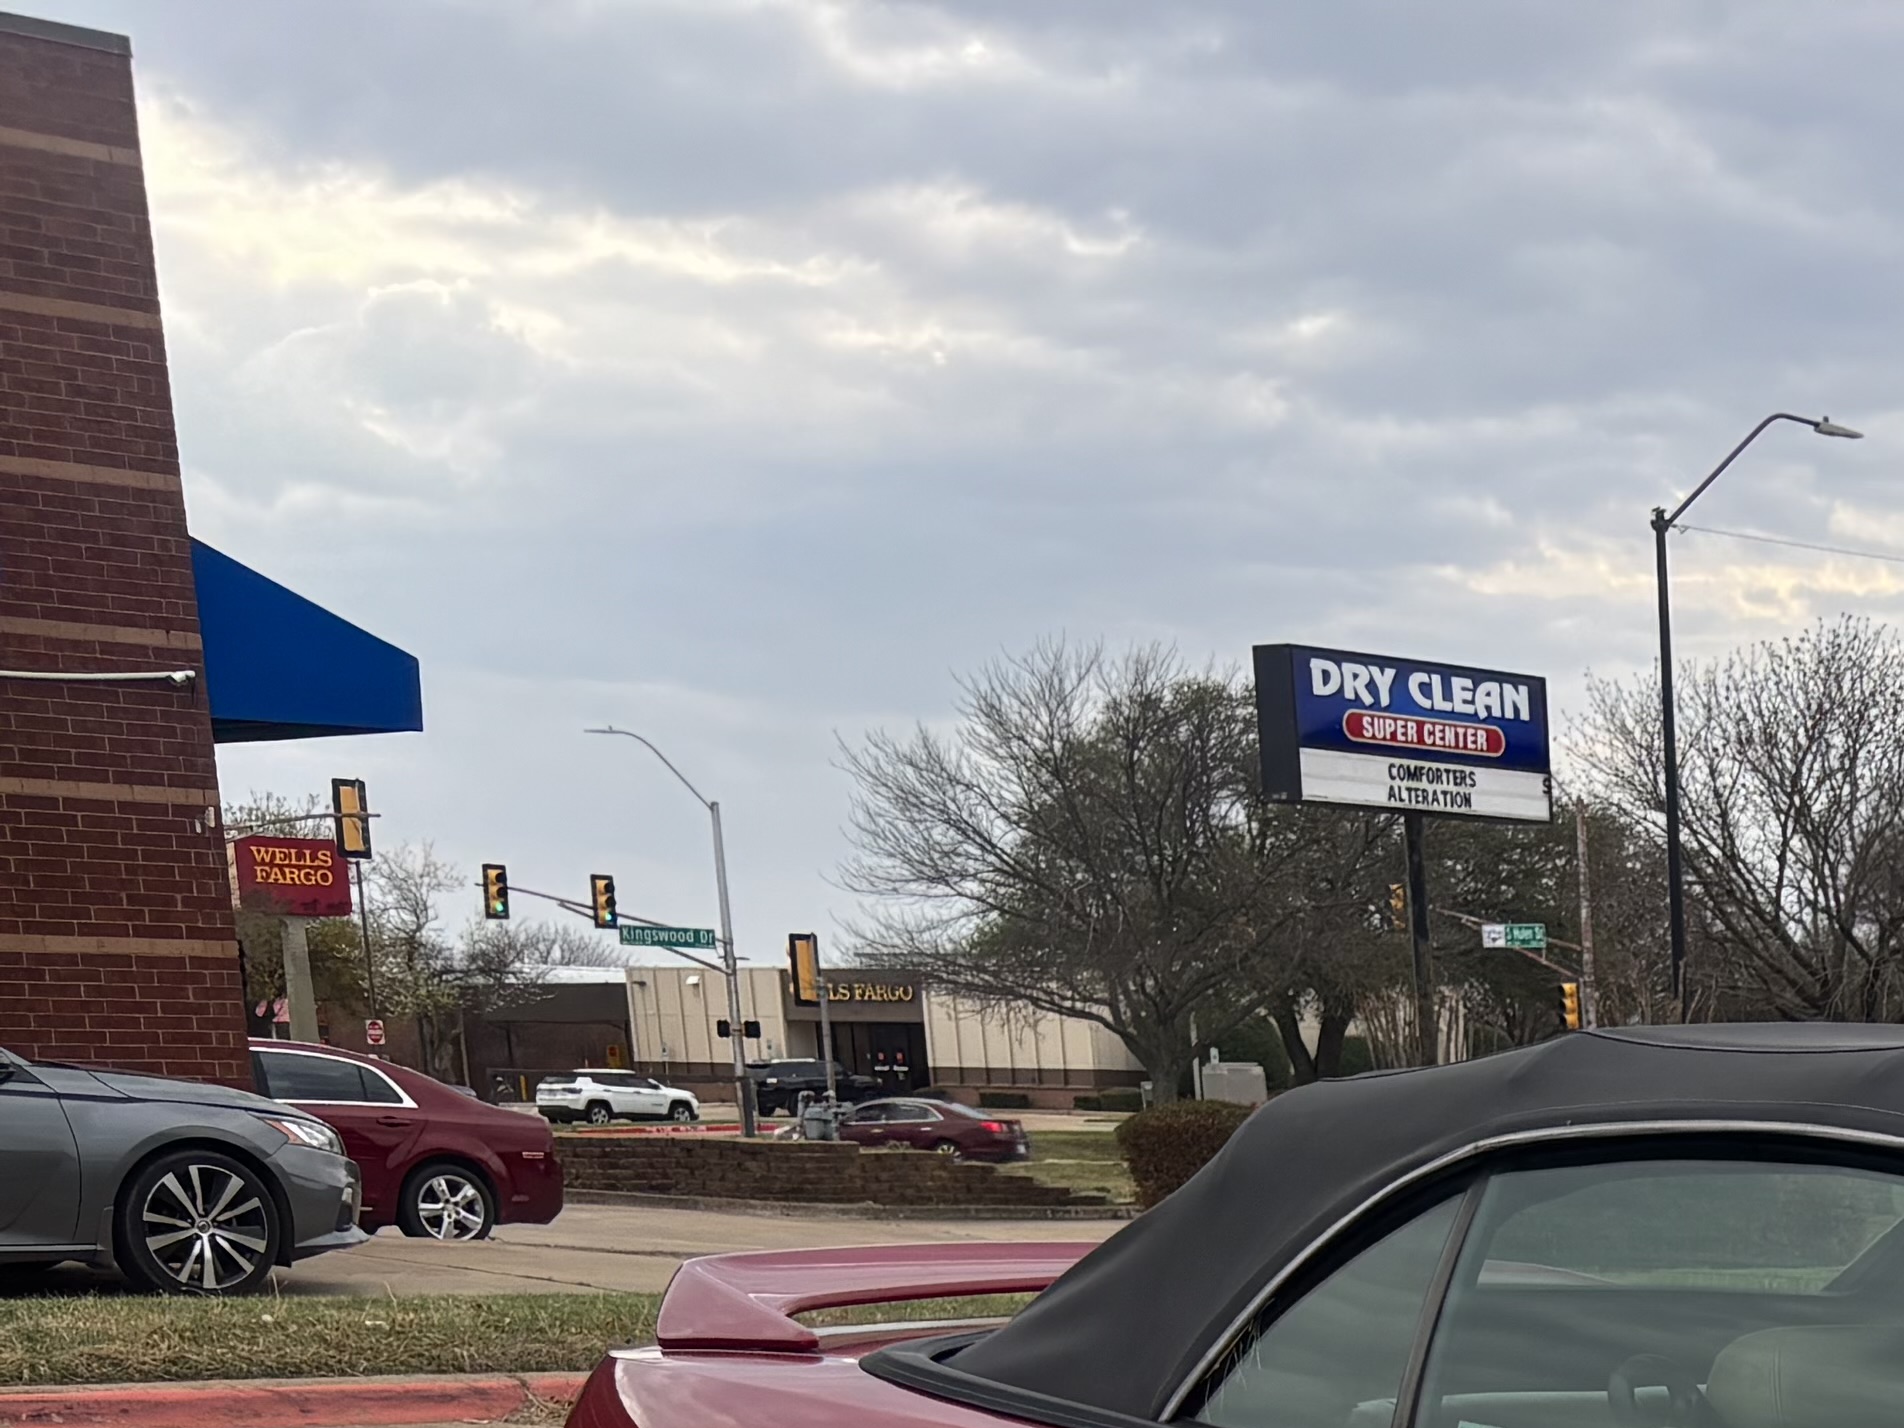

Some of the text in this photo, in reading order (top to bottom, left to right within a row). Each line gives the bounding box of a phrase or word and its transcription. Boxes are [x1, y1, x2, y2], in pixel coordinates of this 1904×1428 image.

[1309, 657, 1531, 722] DRY CLEAN
[1362, 715, 1488, 752] SUPER CENTER
[1388, 762, 1477, 788] COMFORTERS
[1388, 786, 1473, 809] ALTERATION
[249, 845, 333, 867] WELLS
[253, 866, 334, 886] FARGO
[622, 927, 714, 944] Kingswood Dr
[853, 983, 913, 1001] FARGO
